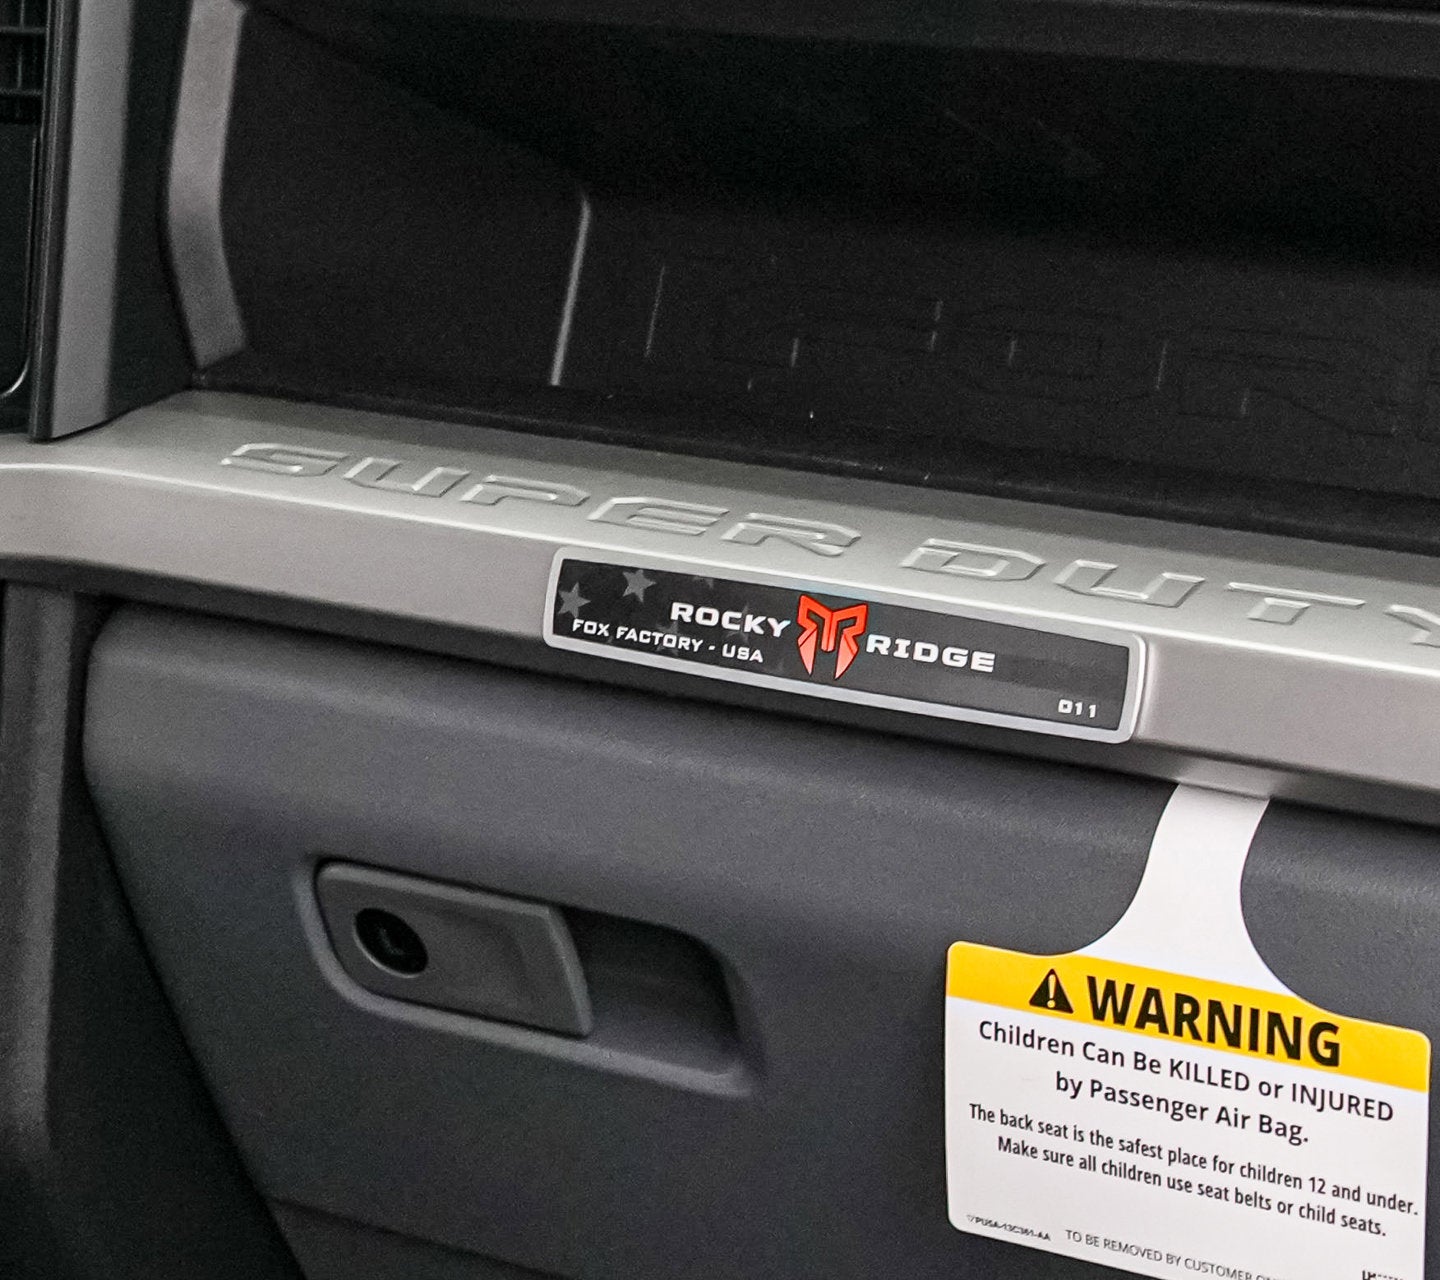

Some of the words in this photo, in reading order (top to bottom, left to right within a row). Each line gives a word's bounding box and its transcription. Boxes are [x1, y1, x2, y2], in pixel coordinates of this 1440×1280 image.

[219, 441, 863, 558] SUPER
[572, 618, 610, 637] FOX
[616, 626, 704, 653] FACTORY
[722, 642, 764, 663] USA
[670, 601, 791, 638] ROCKY
[865, 633, 996, 673] RIDGE
[1057, 698, 1097, 719] 011
[1086, 975, 1340, 1067] WARNING
[979, 1020, 1075, 1058] Children
[1082, 1041, 1125, 1068] Can
[1133, 1051, 1162, 1074] Be
[1169, 1058, 1250, 1092] KILLED
[1258, 1080, 1284, 1099] or
[1291, 1082, 1394, 1121] INJURED
[1056, 1071, 1083, 1100] by
[1089, 1079, 1209, 1122] Passenger
[1215, 1106, 1251, 1130] Air
[1258, 1114, 1309, 1147] Bag.
[969, 1103, 996, 1123] The
[1000, 1109, 1033, 1132] back
[1038, 1121, 1069, 1140] seat
[1073, 1125, 1085, 1143] is
[1089, 1129, 1114, 1149] the
[1118, 1137, 1163, 1160] safest
[1168, 1147, 1208, 1170] place
[1212, 1154, 1235, 1175] for
[1239, 1161, 1303, 1190] children
[1308, 1176, 1327, 1195] 12
[1331, 1185, 1361, 1203] and
[1366, 1192, 1419, 1216] under.
[997, 1135, 1038, 1159] Make
[1043, 1148, 1075, 1167] sure
[1079, 1155, 1097, 1172] all
[1101, 1159, 1162, 1187] children
[1166, 1176, 1193, 1193] use
[1197, 1181, 1230, 1202] seat
[1234, 1187, 1272, 1211] belts
[1277, 1200, 1294, 1216] or
[1298, 1203, 1336, 1225] child
[1340, 1213, 1387, 1237] seats.
[1065, 1228, 1082, 1243] TO
[1085, 1234, 1100, 1249] BE
[1103, 1238, 1163, 1262] REMOVED
[1166, 1252, 1182, 1268] BY
